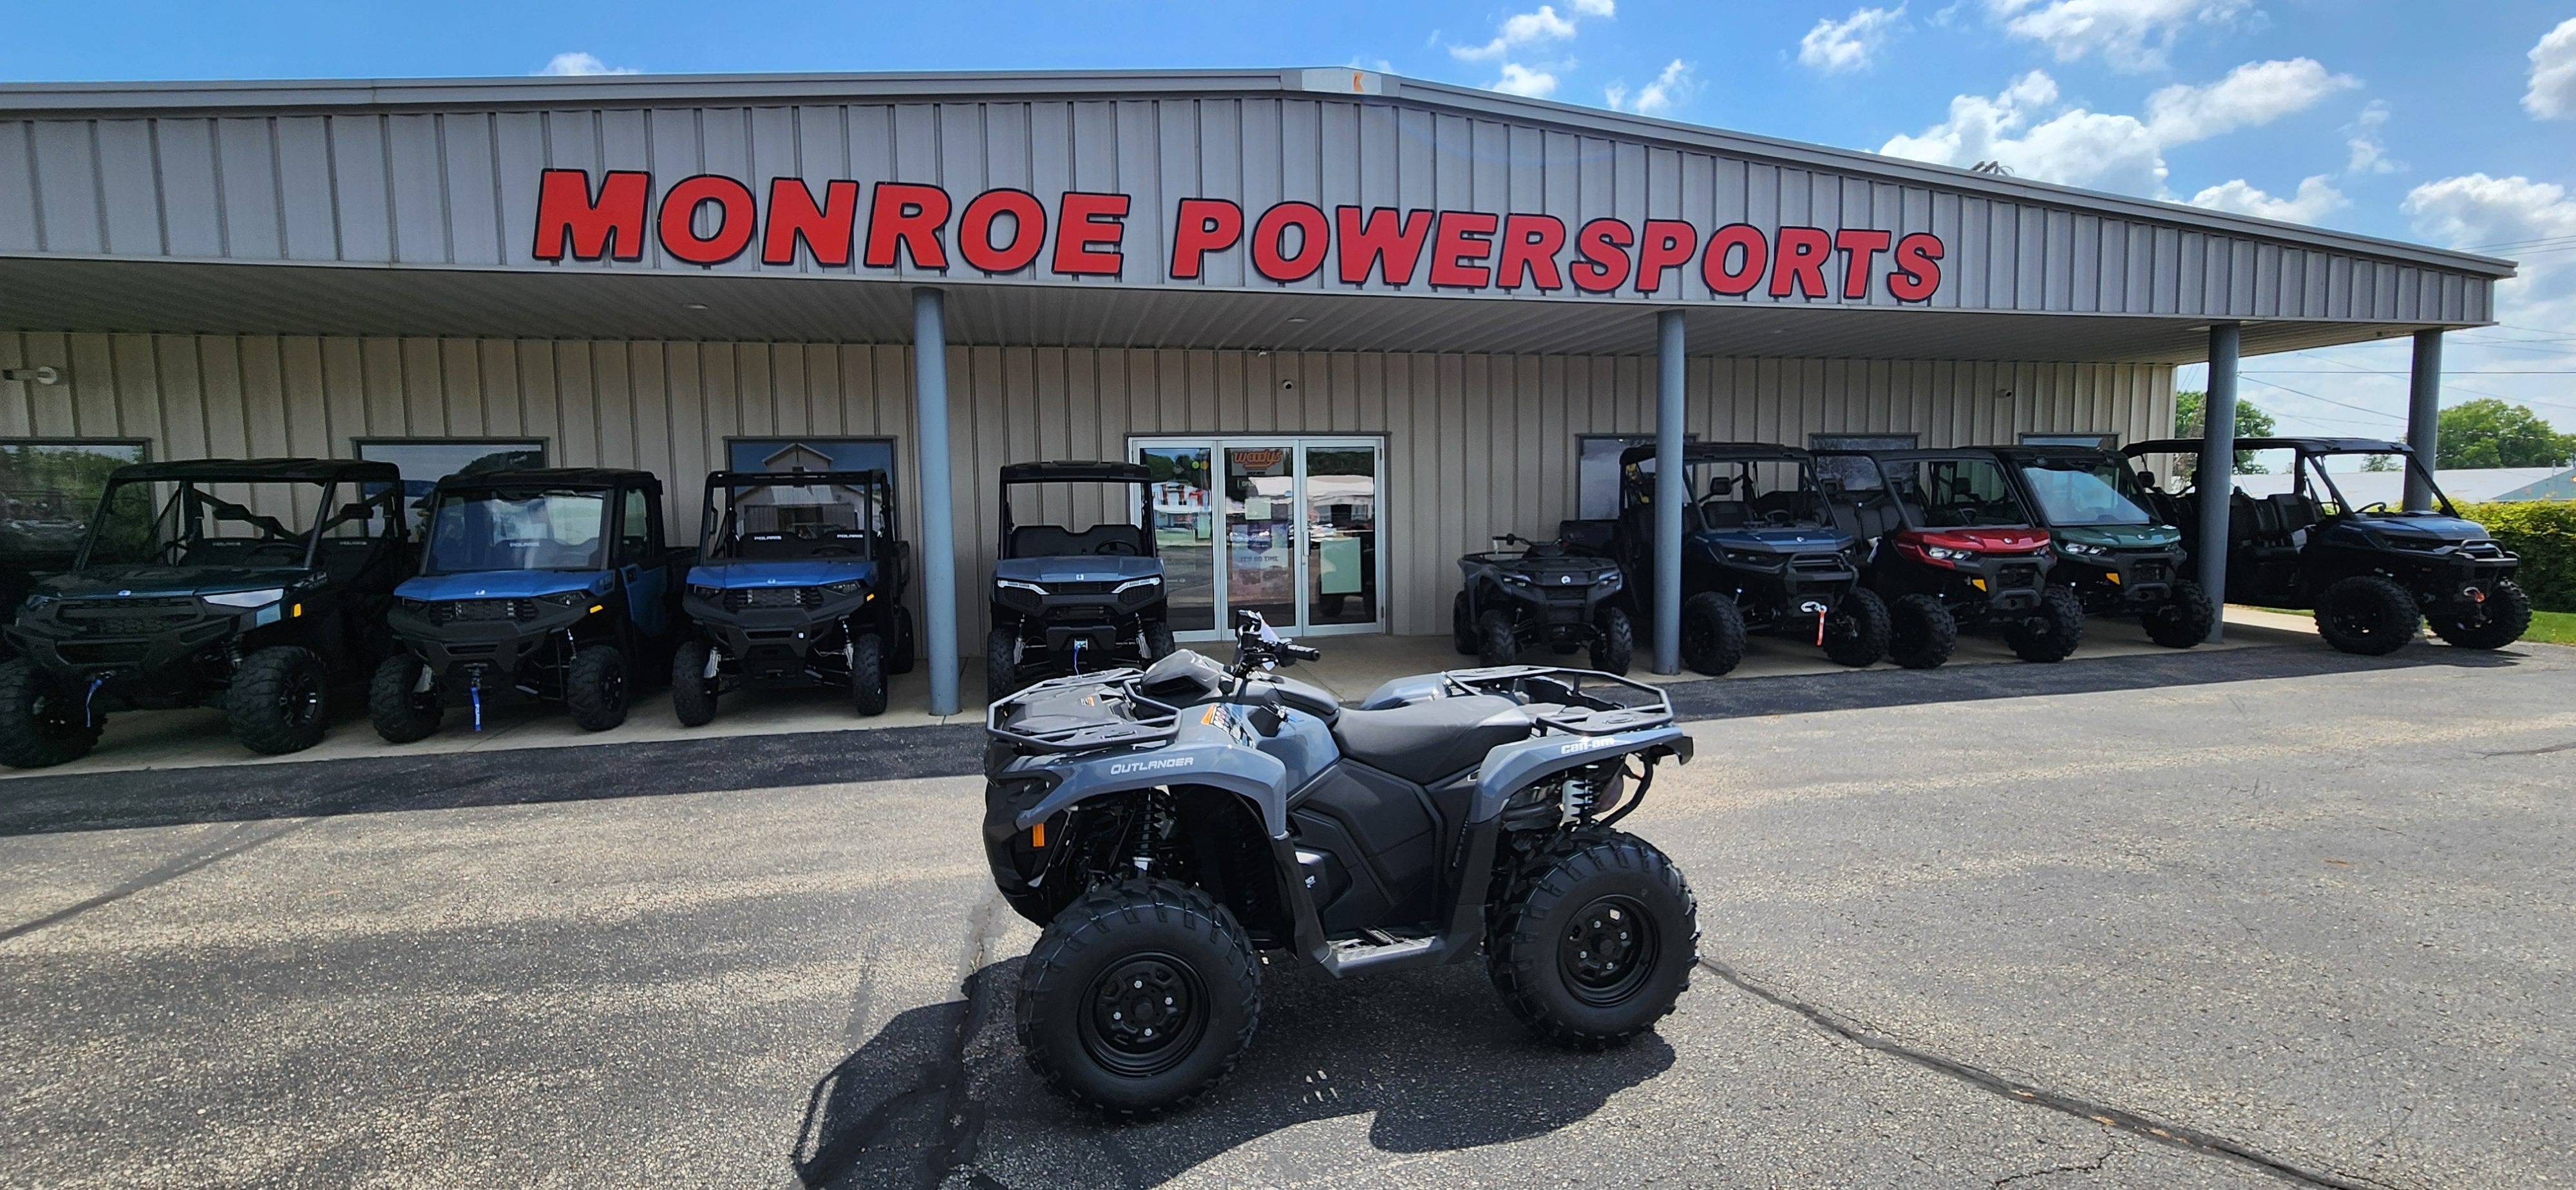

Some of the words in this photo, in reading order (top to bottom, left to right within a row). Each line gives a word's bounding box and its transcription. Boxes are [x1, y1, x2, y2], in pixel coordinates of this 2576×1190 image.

[532, 168, 1131, 274] MONROE
[1169, 197, 1945, 301] POWERSPORTS
[1233, 449, 1282, 468] woody's
[1561, 737, 1615, 754] can-am
[1110, 757, 1194, 775] OUTLANDER
